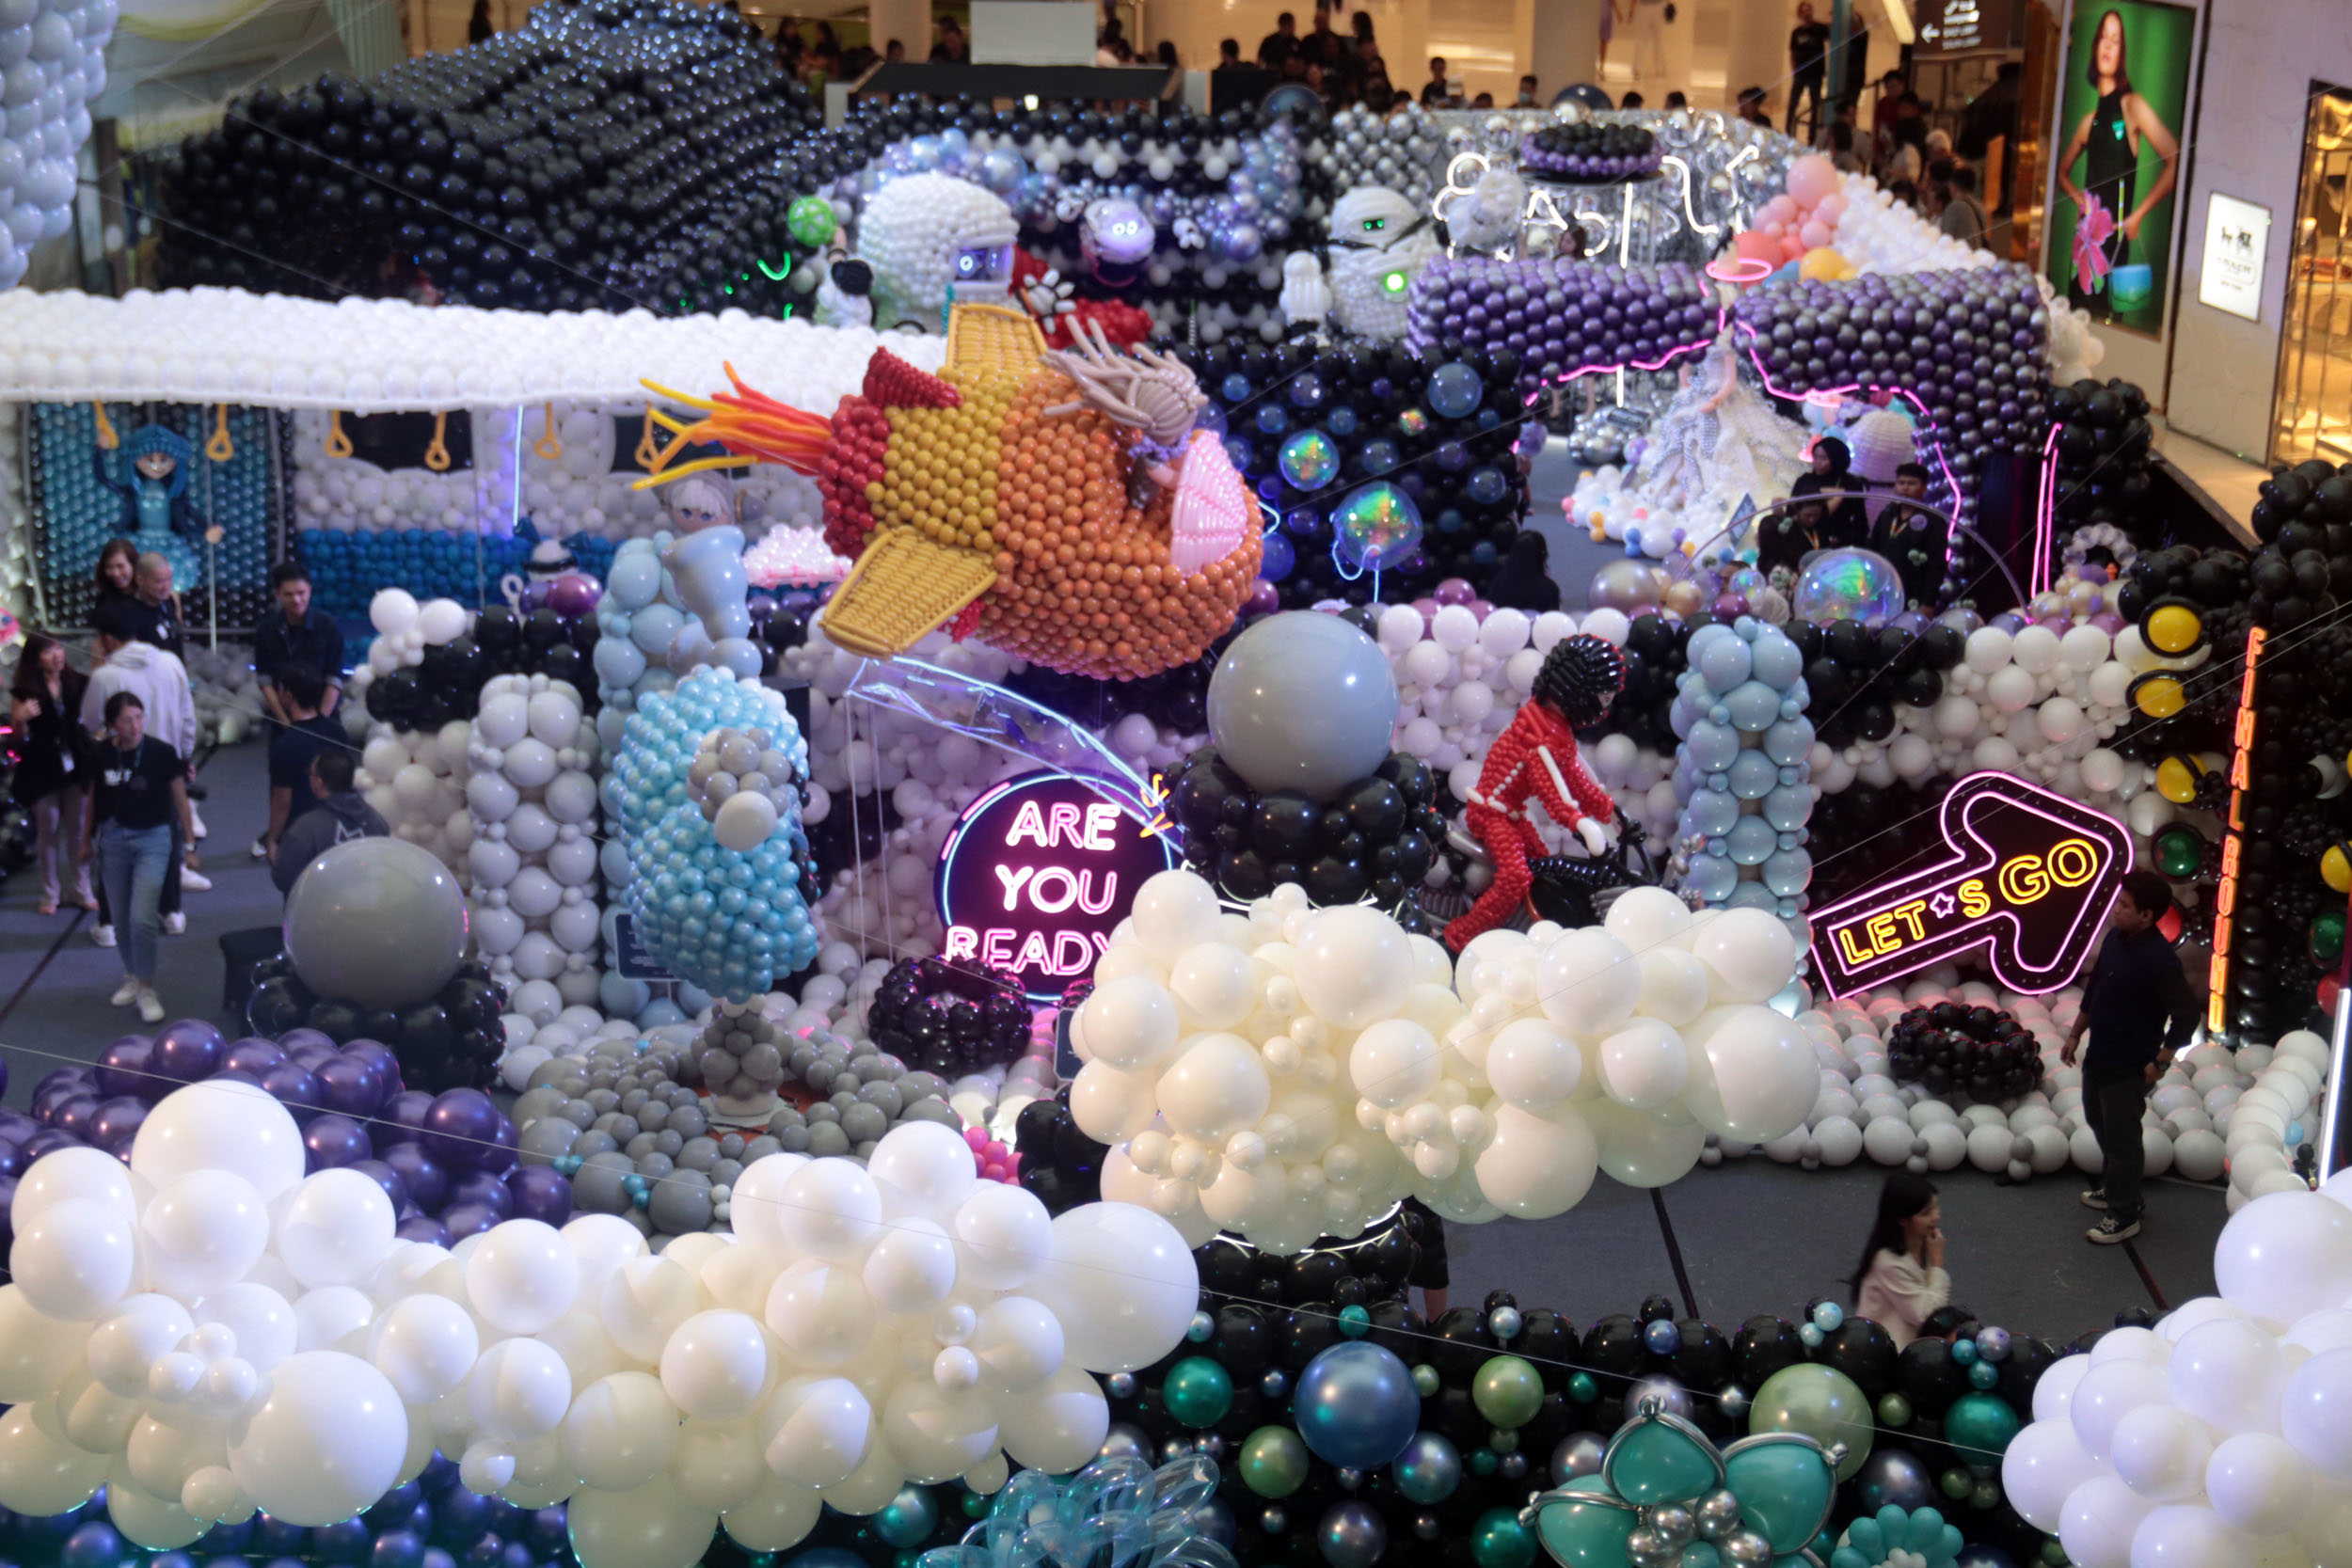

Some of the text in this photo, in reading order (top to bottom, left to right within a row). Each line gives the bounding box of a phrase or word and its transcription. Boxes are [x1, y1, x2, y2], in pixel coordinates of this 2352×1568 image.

[1005, 800, 1121, 851] ARE
[2208, 626, 2267, 1033] FINAL ROUND
[994, 863, 1118, 915] YOU
[1998, 838, 2098, 905] GO
